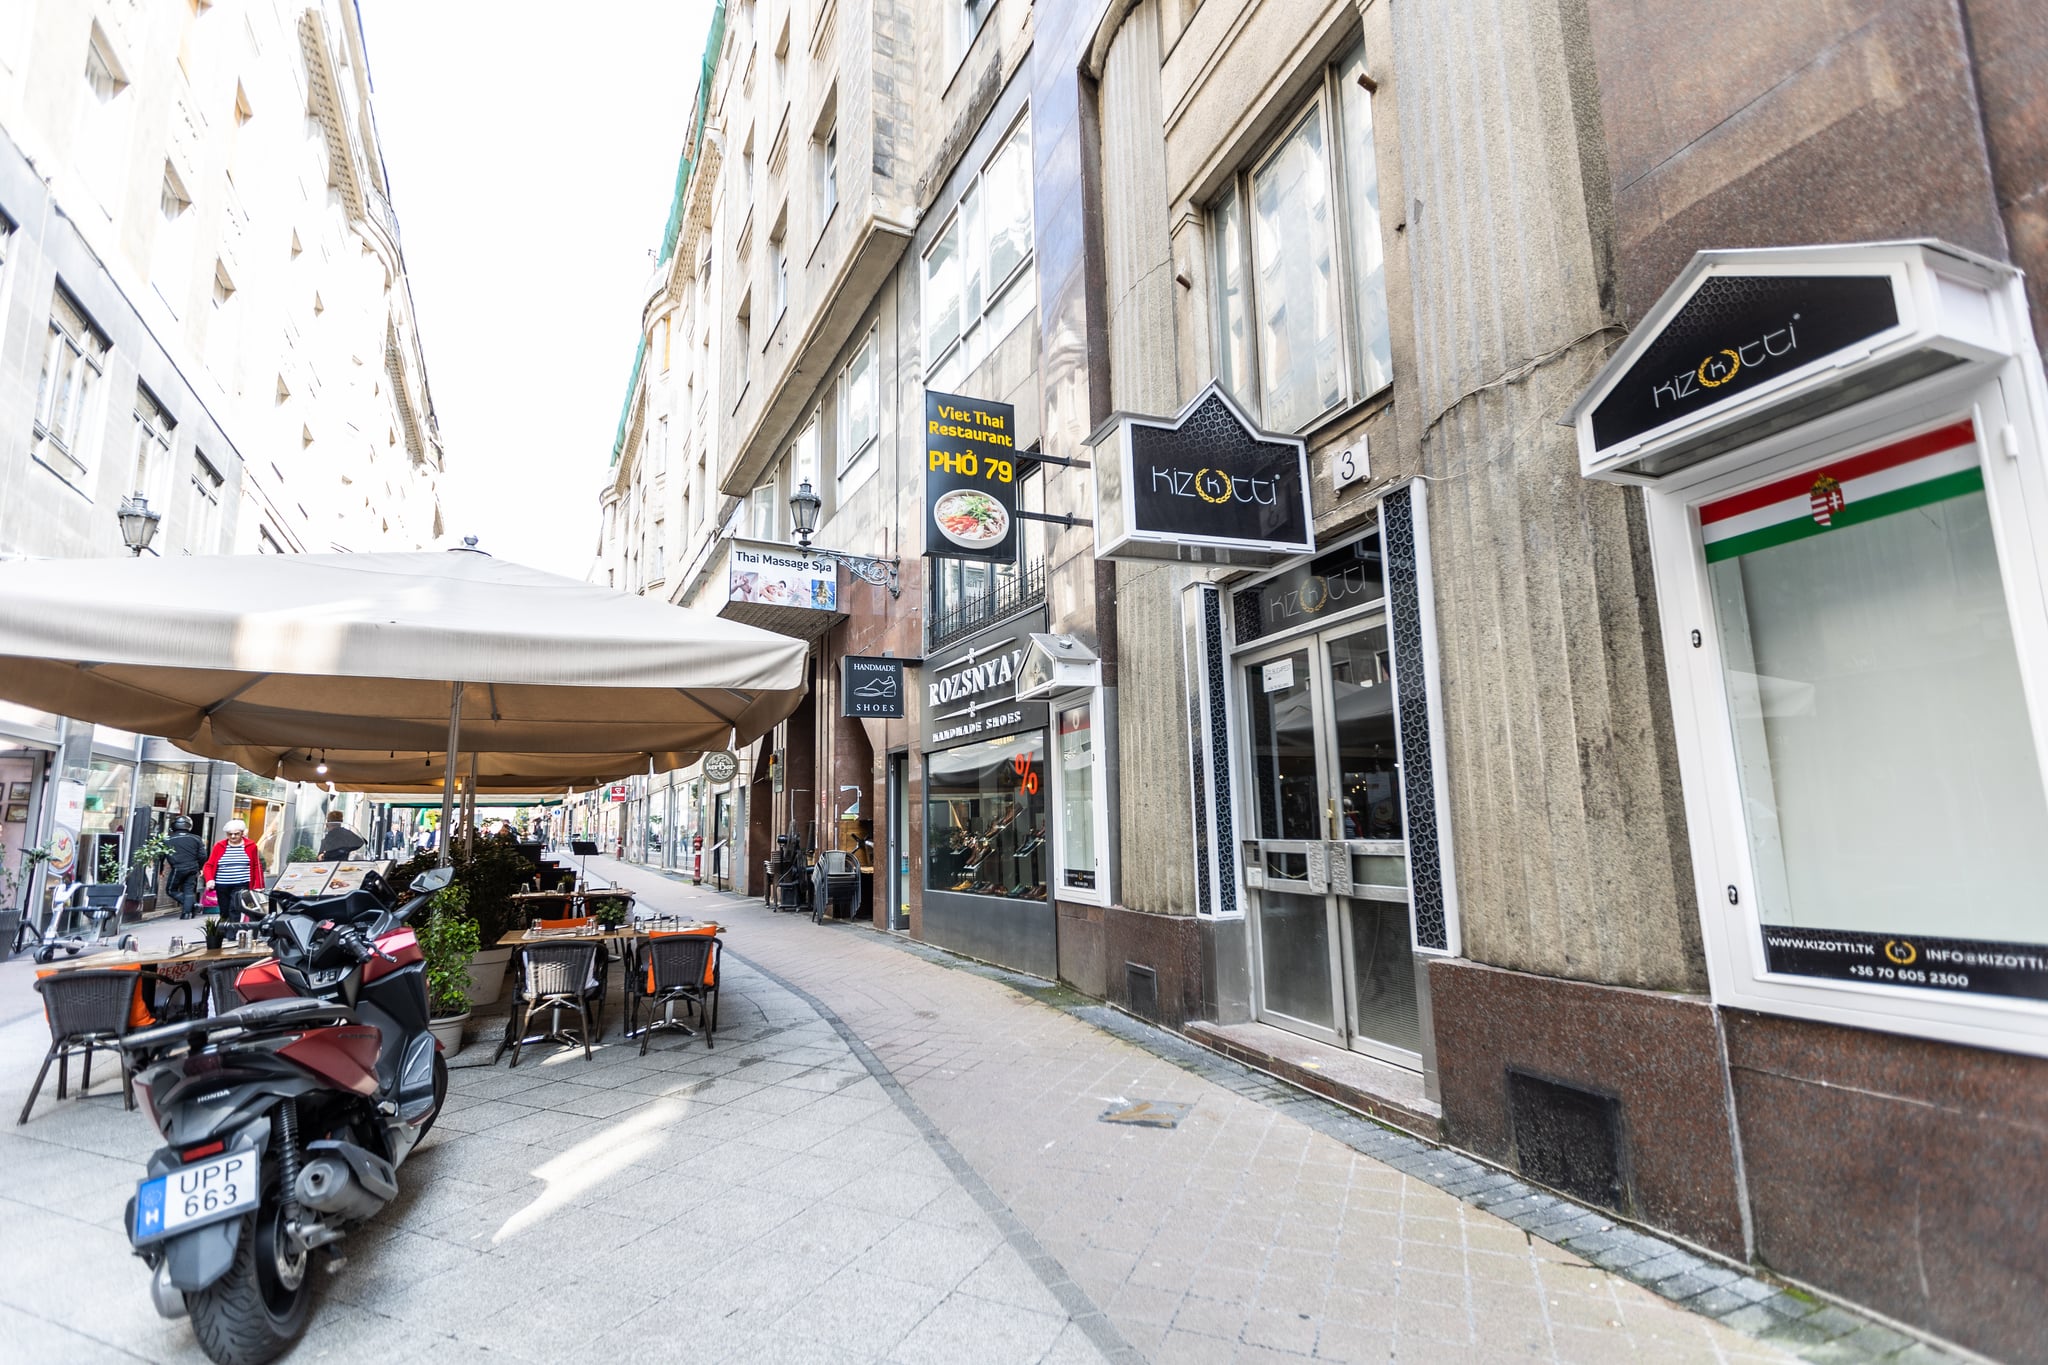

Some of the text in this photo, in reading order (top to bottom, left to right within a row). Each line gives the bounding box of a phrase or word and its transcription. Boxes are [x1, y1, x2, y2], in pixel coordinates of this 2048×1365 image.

[938, 405, 1004, 429] Viet Thai
[929, 420, 1013, 447] Restaurant
[984, 457, 1013, 483] 79
[1341, 450, 1356, 480] 3
[736, 551, 832, 573] Thai Massage Spa
[853, 663, 896, 672] HANDMADE
[856, 703, 895, 712] SHOES
[932, 711, 1021, 743] HANDMADE SHOES
[1015, 751, 1038, 796] %
[1768, 937, 1875, 955] WWW.KIZOTTI.TK
[1925, 948, 2048, 970] INFO@KIZOTTI.
[1849, 964, 1969, 988] +36 70 605 2300
[197, 1089, 231, 1103] HONDA
[180, 1159, 242, 1194] UPP
[184, 1184, 237, 1217] 663
[145, 1208, 159, 1226] H
